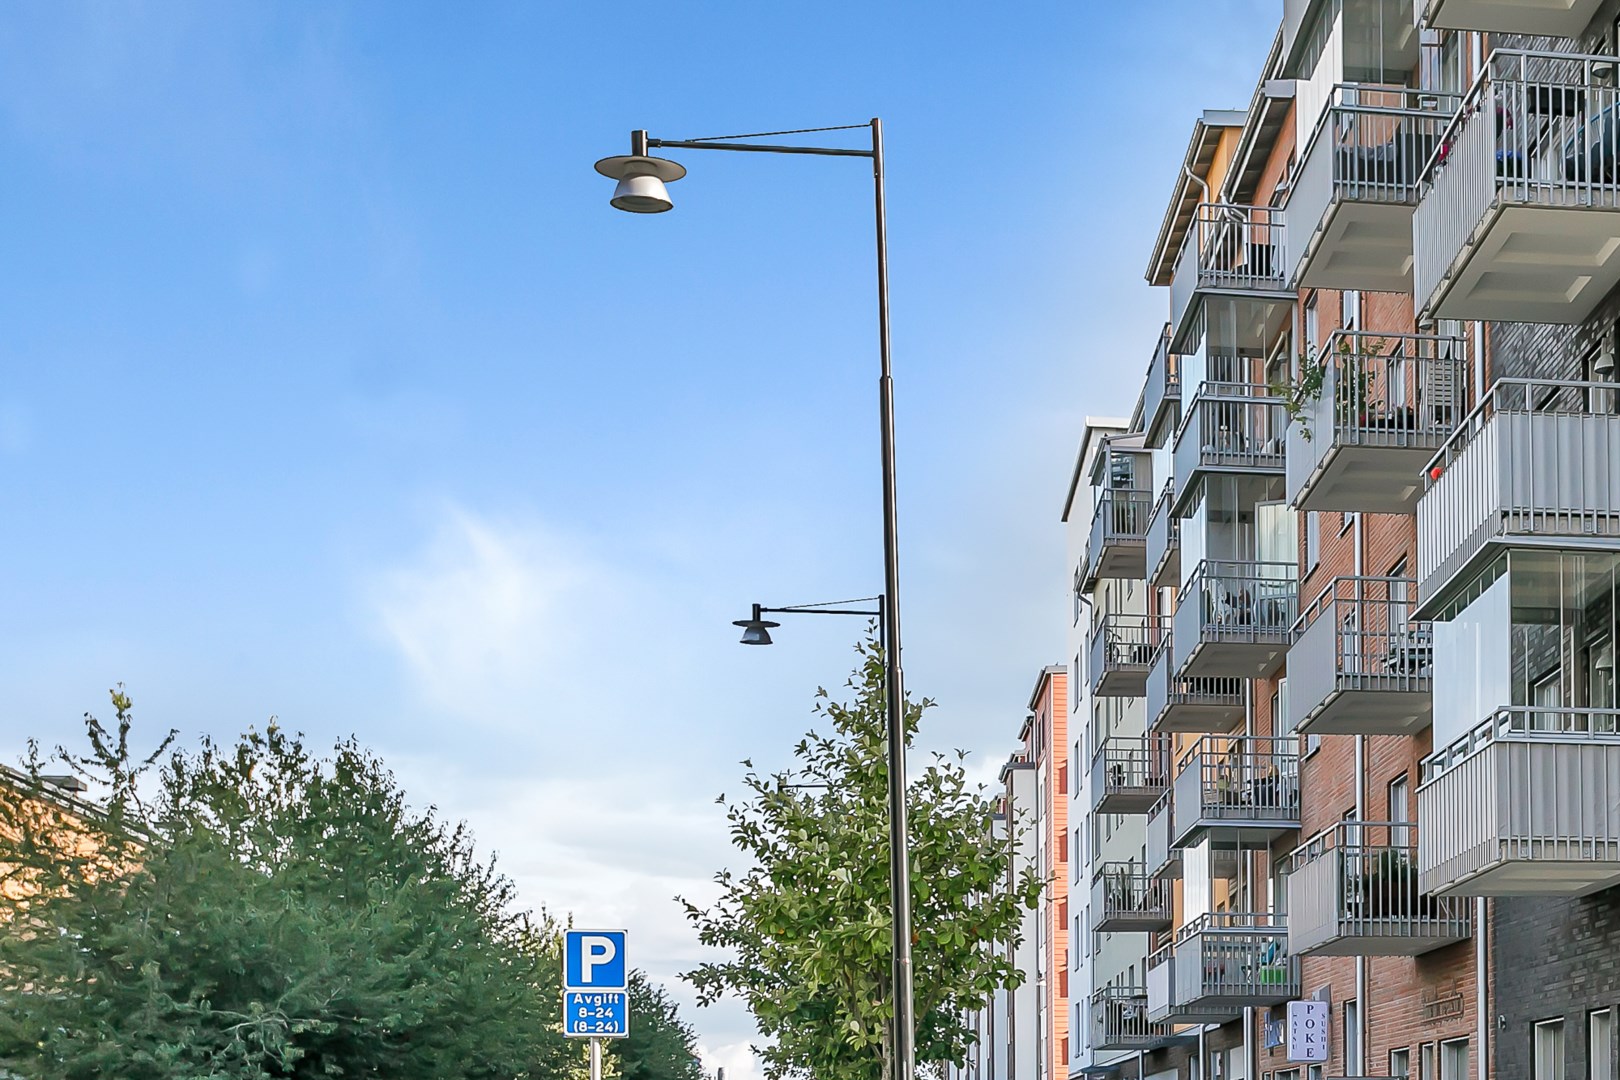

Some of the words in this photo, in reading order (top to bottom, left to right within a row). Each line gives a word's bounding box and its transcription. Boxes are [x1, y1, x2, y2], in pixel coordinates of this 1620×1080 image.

[581, 936, 616, 983] P
[573, 993, 619, 1006] Avgift
[578, 1007, 614, 1018] 8-24
[573, 1020, 619, 1033] (8-24)
[1305, 1004, 1315, 1058] POKE
